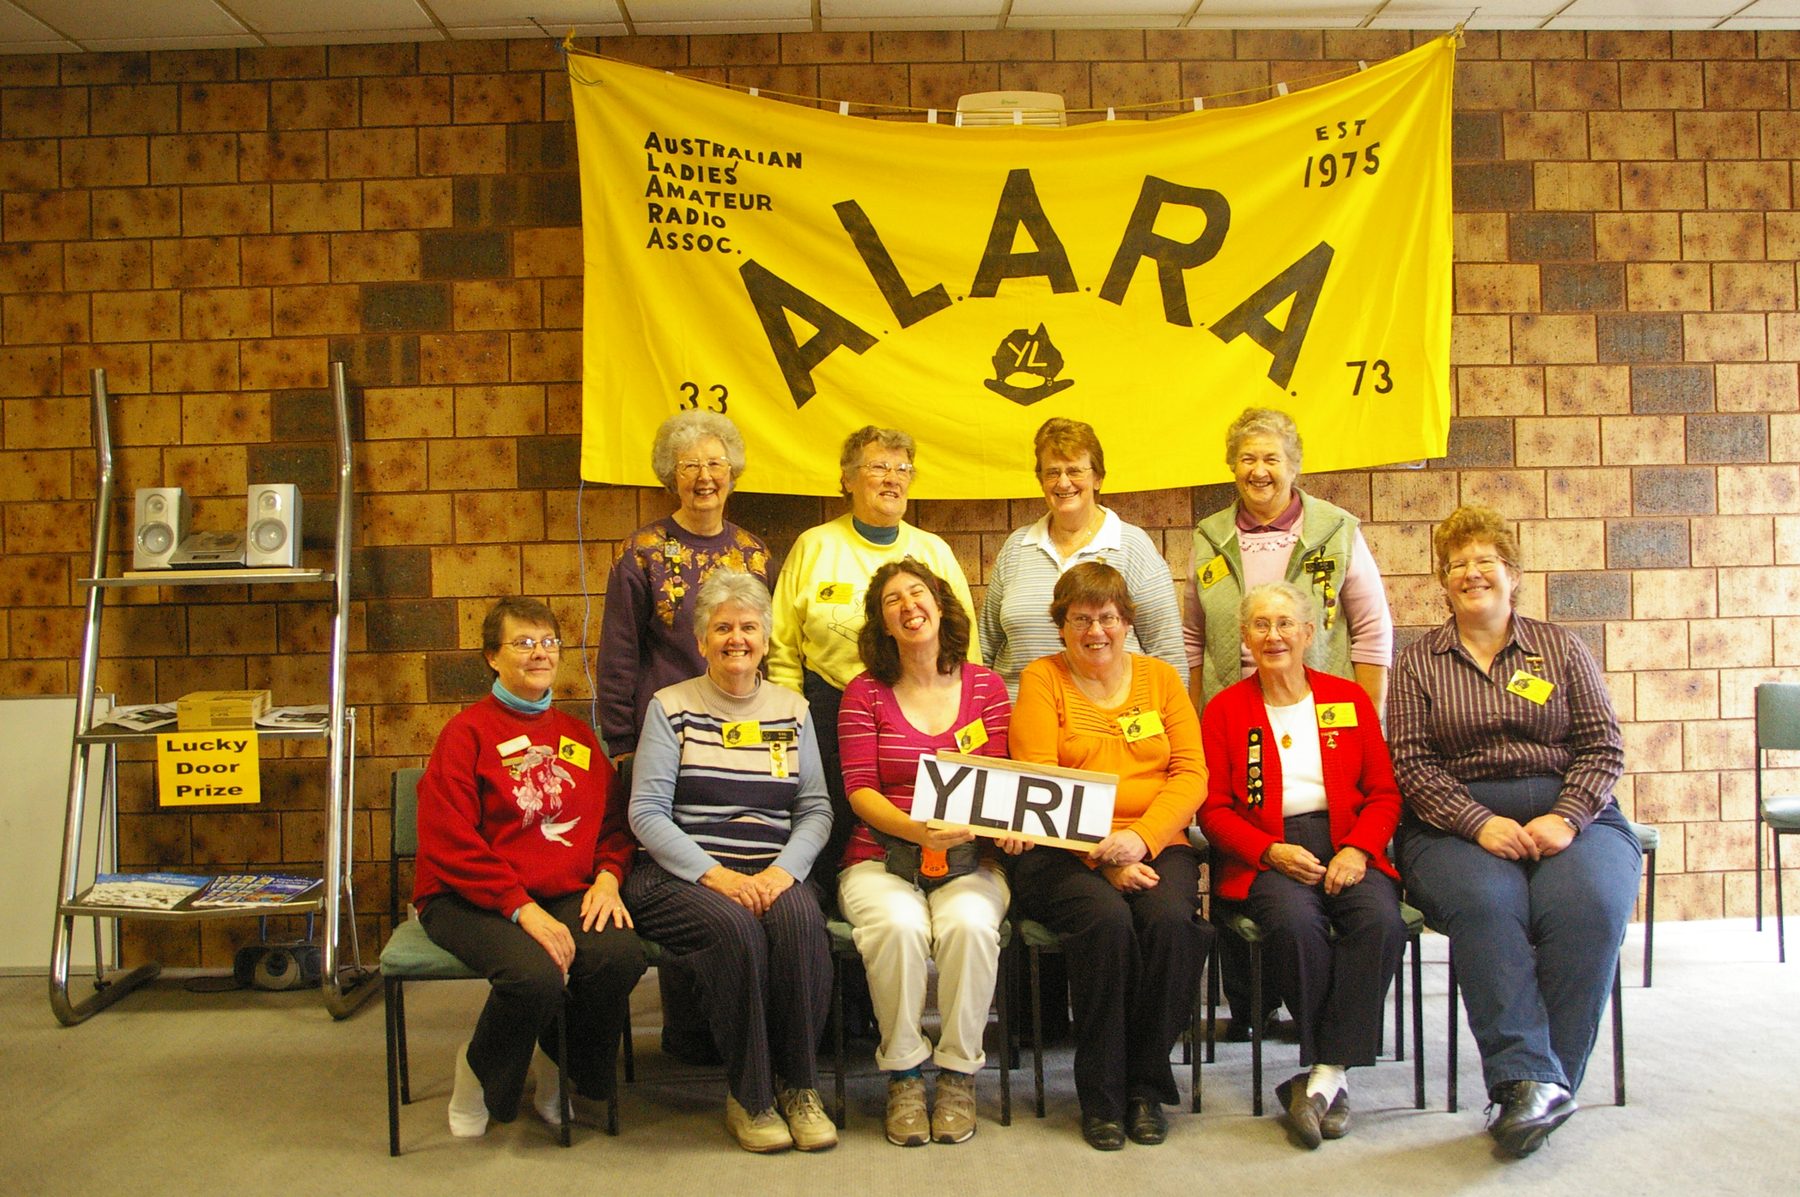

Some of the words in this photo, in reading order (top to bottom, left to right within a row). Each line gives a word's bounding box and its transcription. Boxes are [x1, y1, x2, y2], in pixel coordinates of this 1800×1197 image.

[1316, 119, 1367, 141] EST
[644, 132, 802, 169] AUSTRALIAN
[1304, 142, 1380, 188] 1975
[645, 174, 773, 211] AMATEUR
[648, 203, 726, 229] RADIO
[646, 227, 742, 255] ASSOC.
[1007, 341, 1048, 367] YL
[1346, 359, 1393, 396] 73
[680, 381, 728, 414] 33
[167, 738, 248, 753] Lucky
[177, 763, 240, 774] Door
[177, 784, 243, 797] Prize
[924, 759, 1106, 844] YLRL
